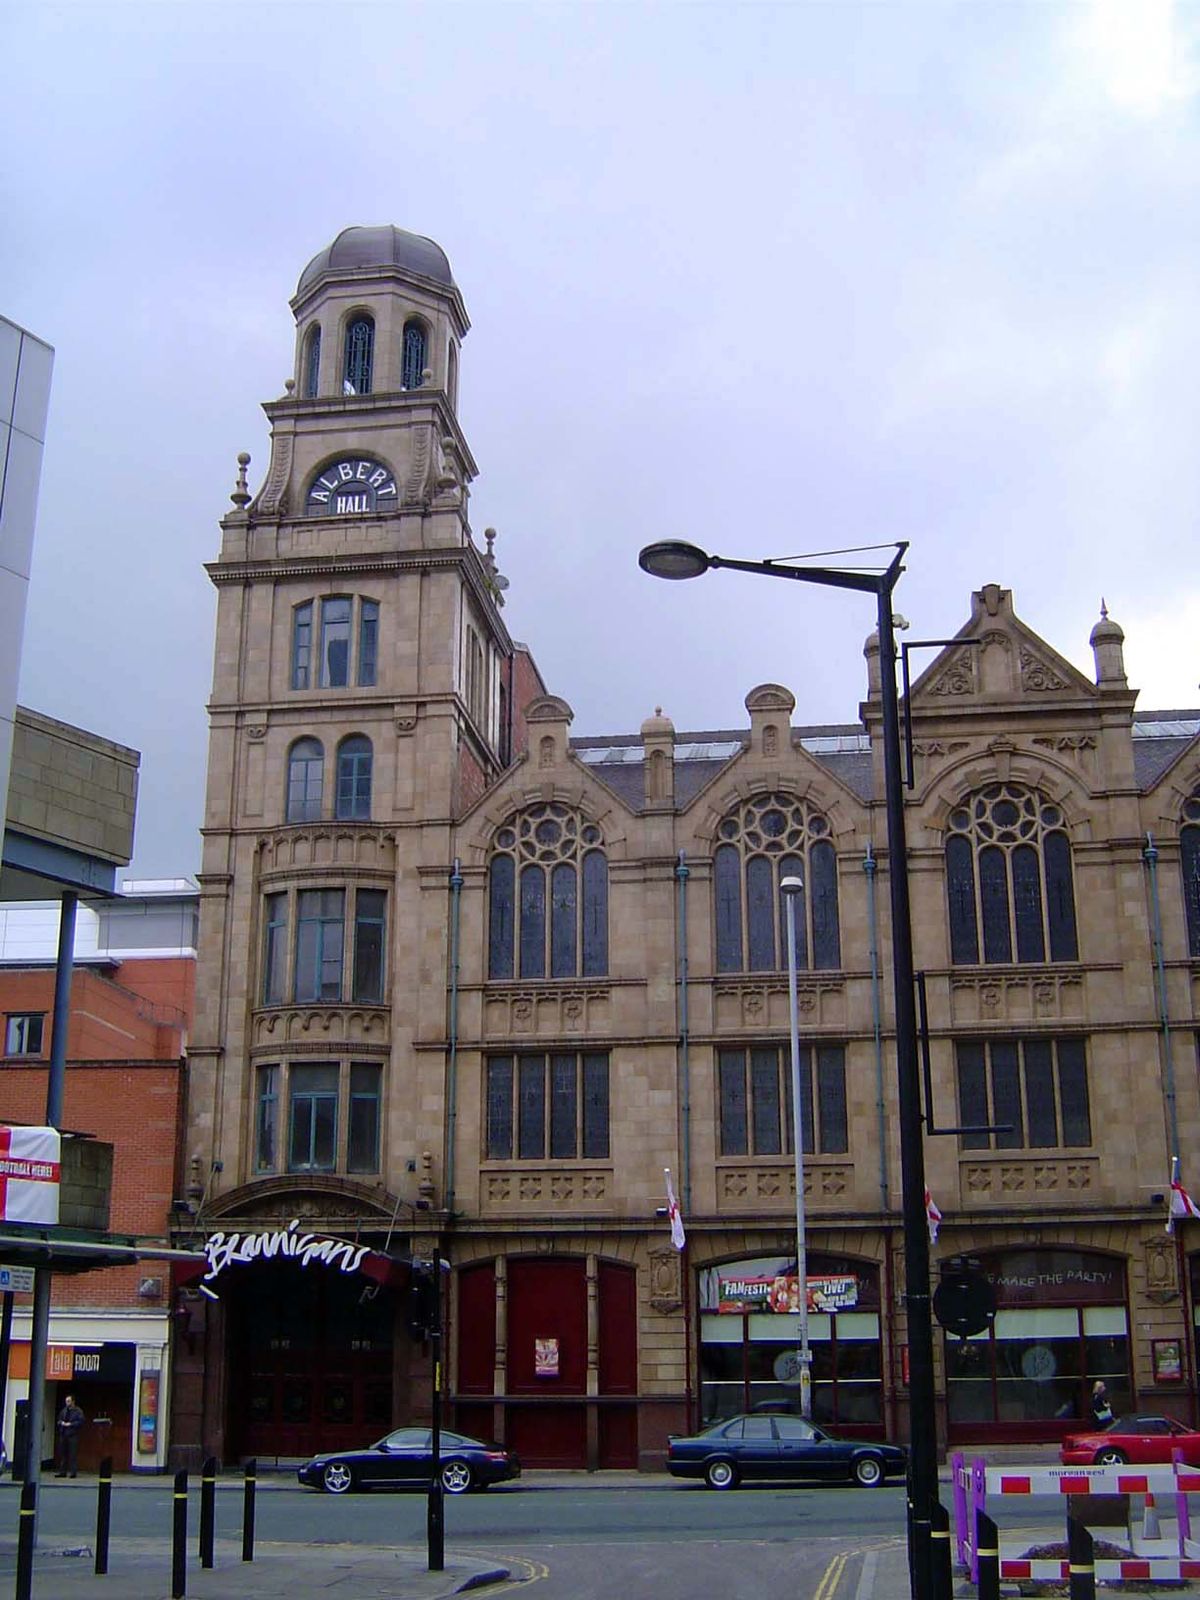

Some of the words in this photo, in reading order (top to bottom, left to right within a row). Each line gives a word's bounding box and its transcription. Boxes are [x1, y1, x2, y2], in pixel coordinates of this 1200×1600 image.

[311, 462, 396, 502] ALBERT
[337, 495, 370, 514] HALL
[1038, 1273, 1063, 1285] THE
[1067, 1270, 1112, 1285] PARTY!
